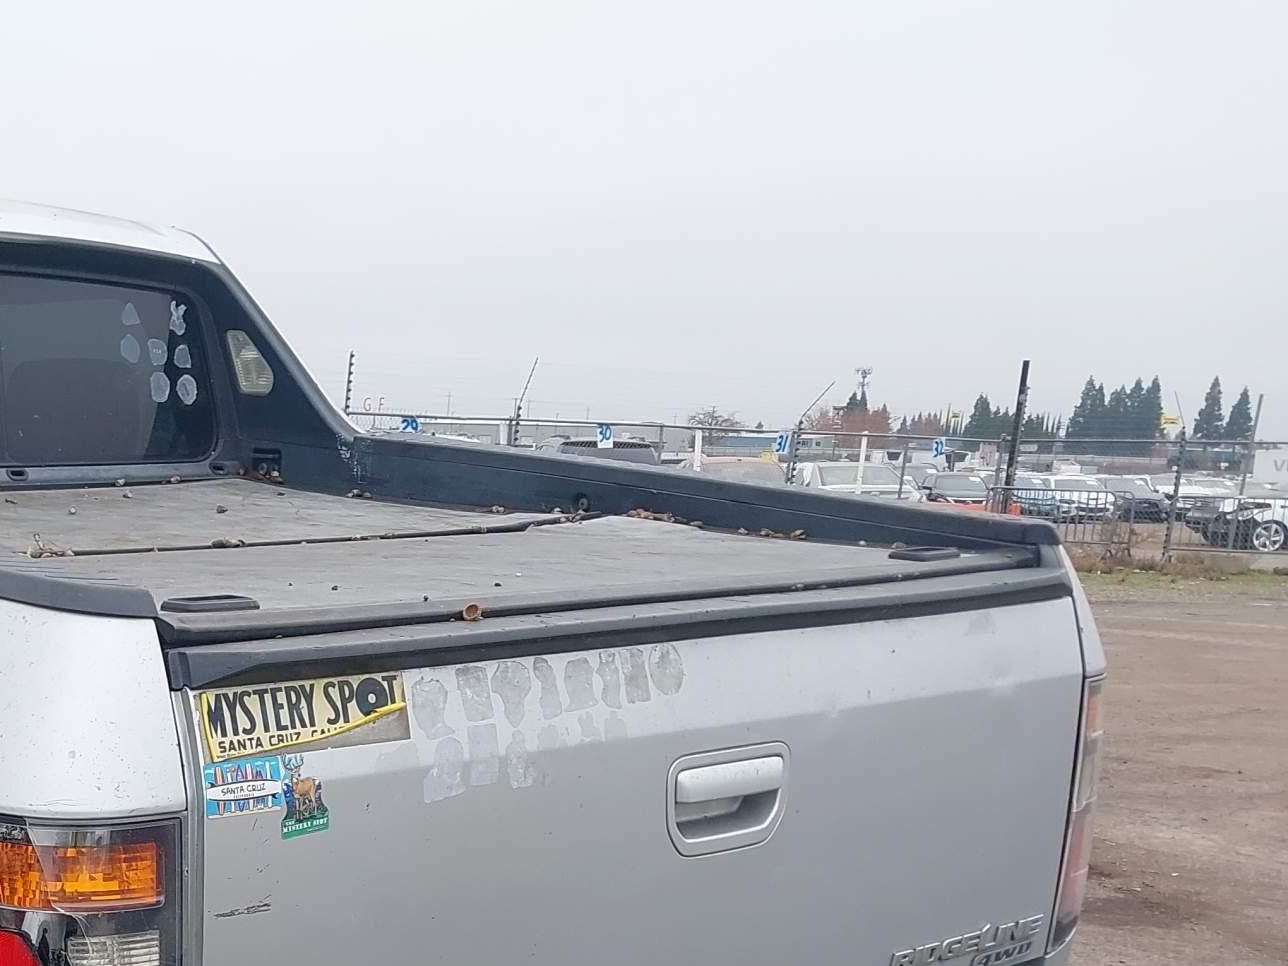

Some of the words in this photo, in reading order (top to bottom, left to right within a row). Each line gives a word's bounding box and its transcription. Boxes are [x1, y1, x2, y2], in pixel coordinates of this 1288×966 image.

[599, 423, 613, 443] 30
[775, 434, 789, 453] 31
[207, 683, 316, 739] MYSTERY
[322, 675, 398, 726] SPOT
[218, 737, 264, 754] SANTA
[221, 785, 244, 797] SANTA
[246, 782, 266, 793] CRUZ
